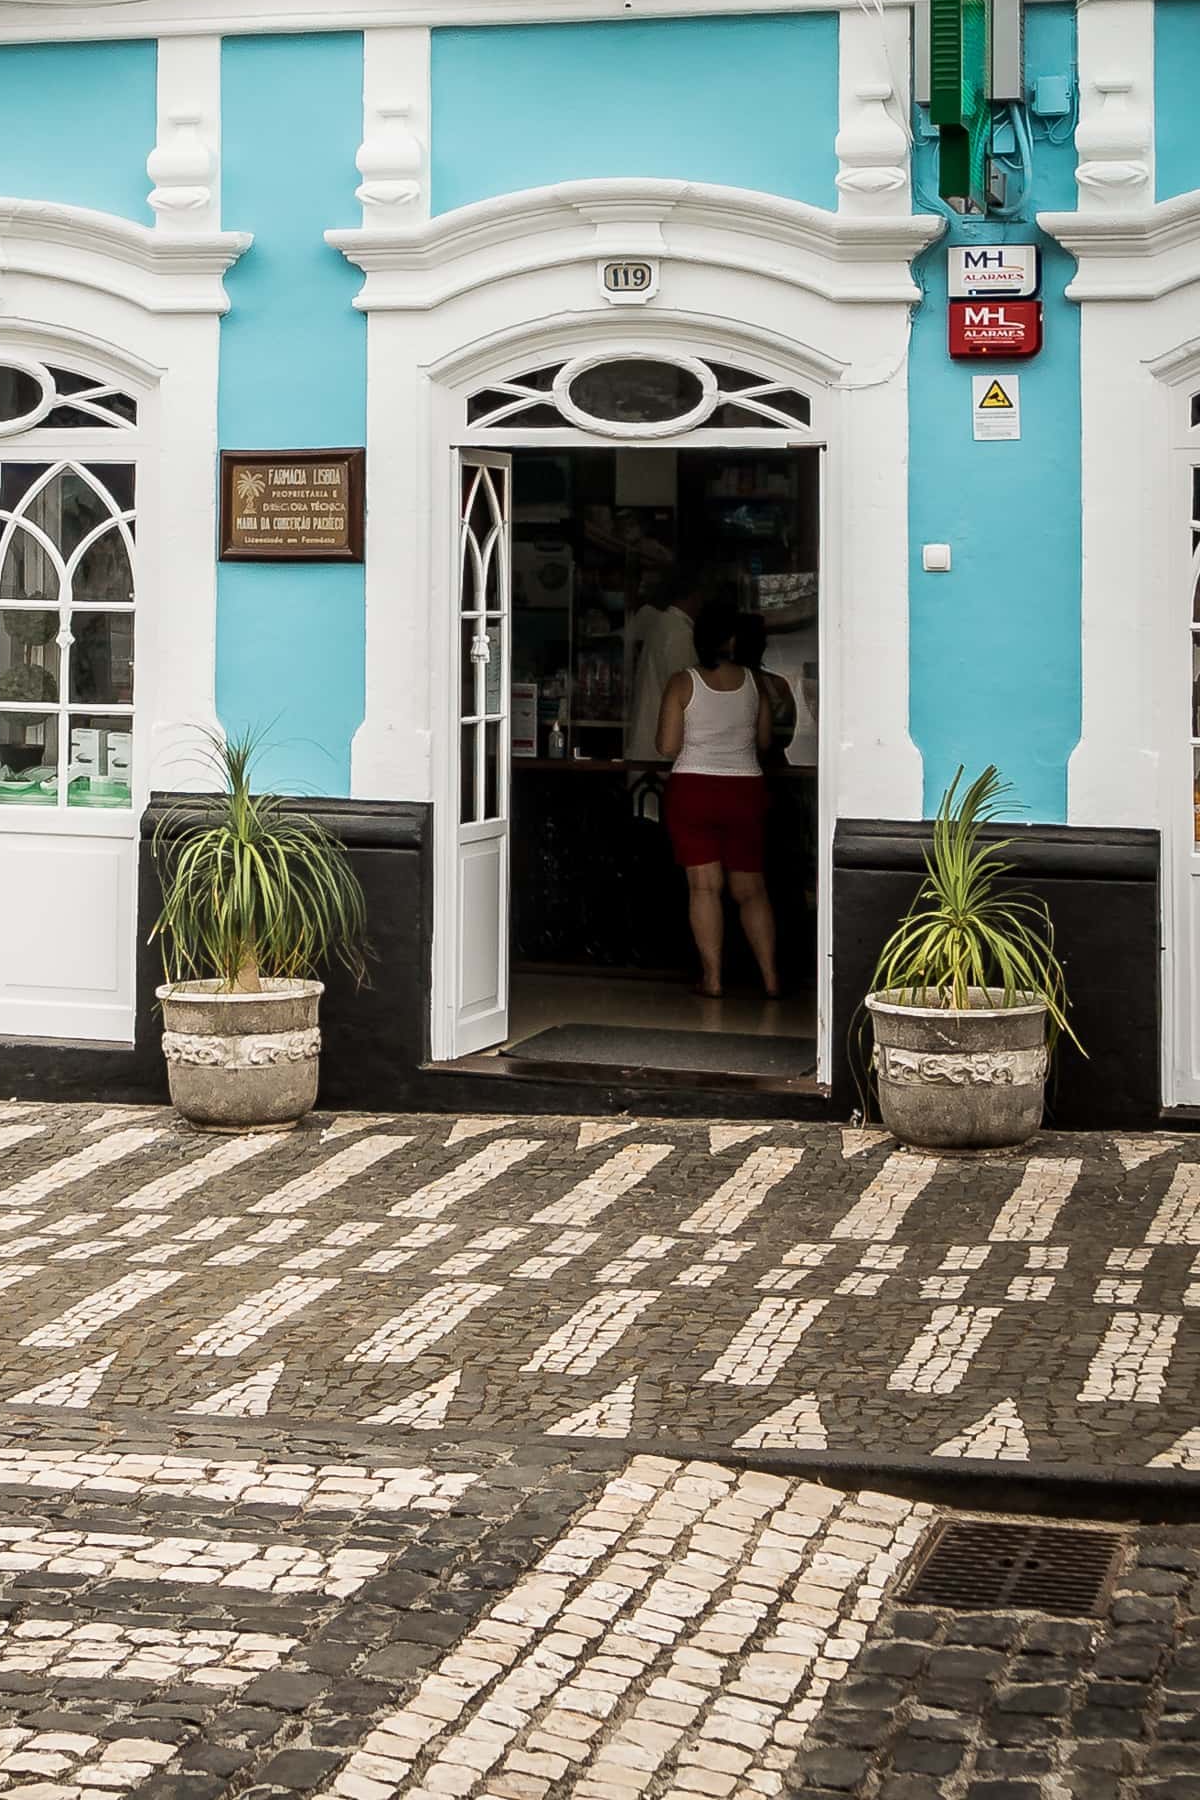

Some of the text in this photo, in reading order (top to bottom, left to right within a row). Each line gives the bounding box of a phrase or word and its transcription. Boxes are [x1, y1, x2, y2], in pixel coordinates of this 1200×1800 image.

[612, 267, 646, 287] 119
[964, 273, 1024, 281] ALARMES
[964, 329, 1024, 337] ALARMES
[313, 468, 341, 485] LISBOA
